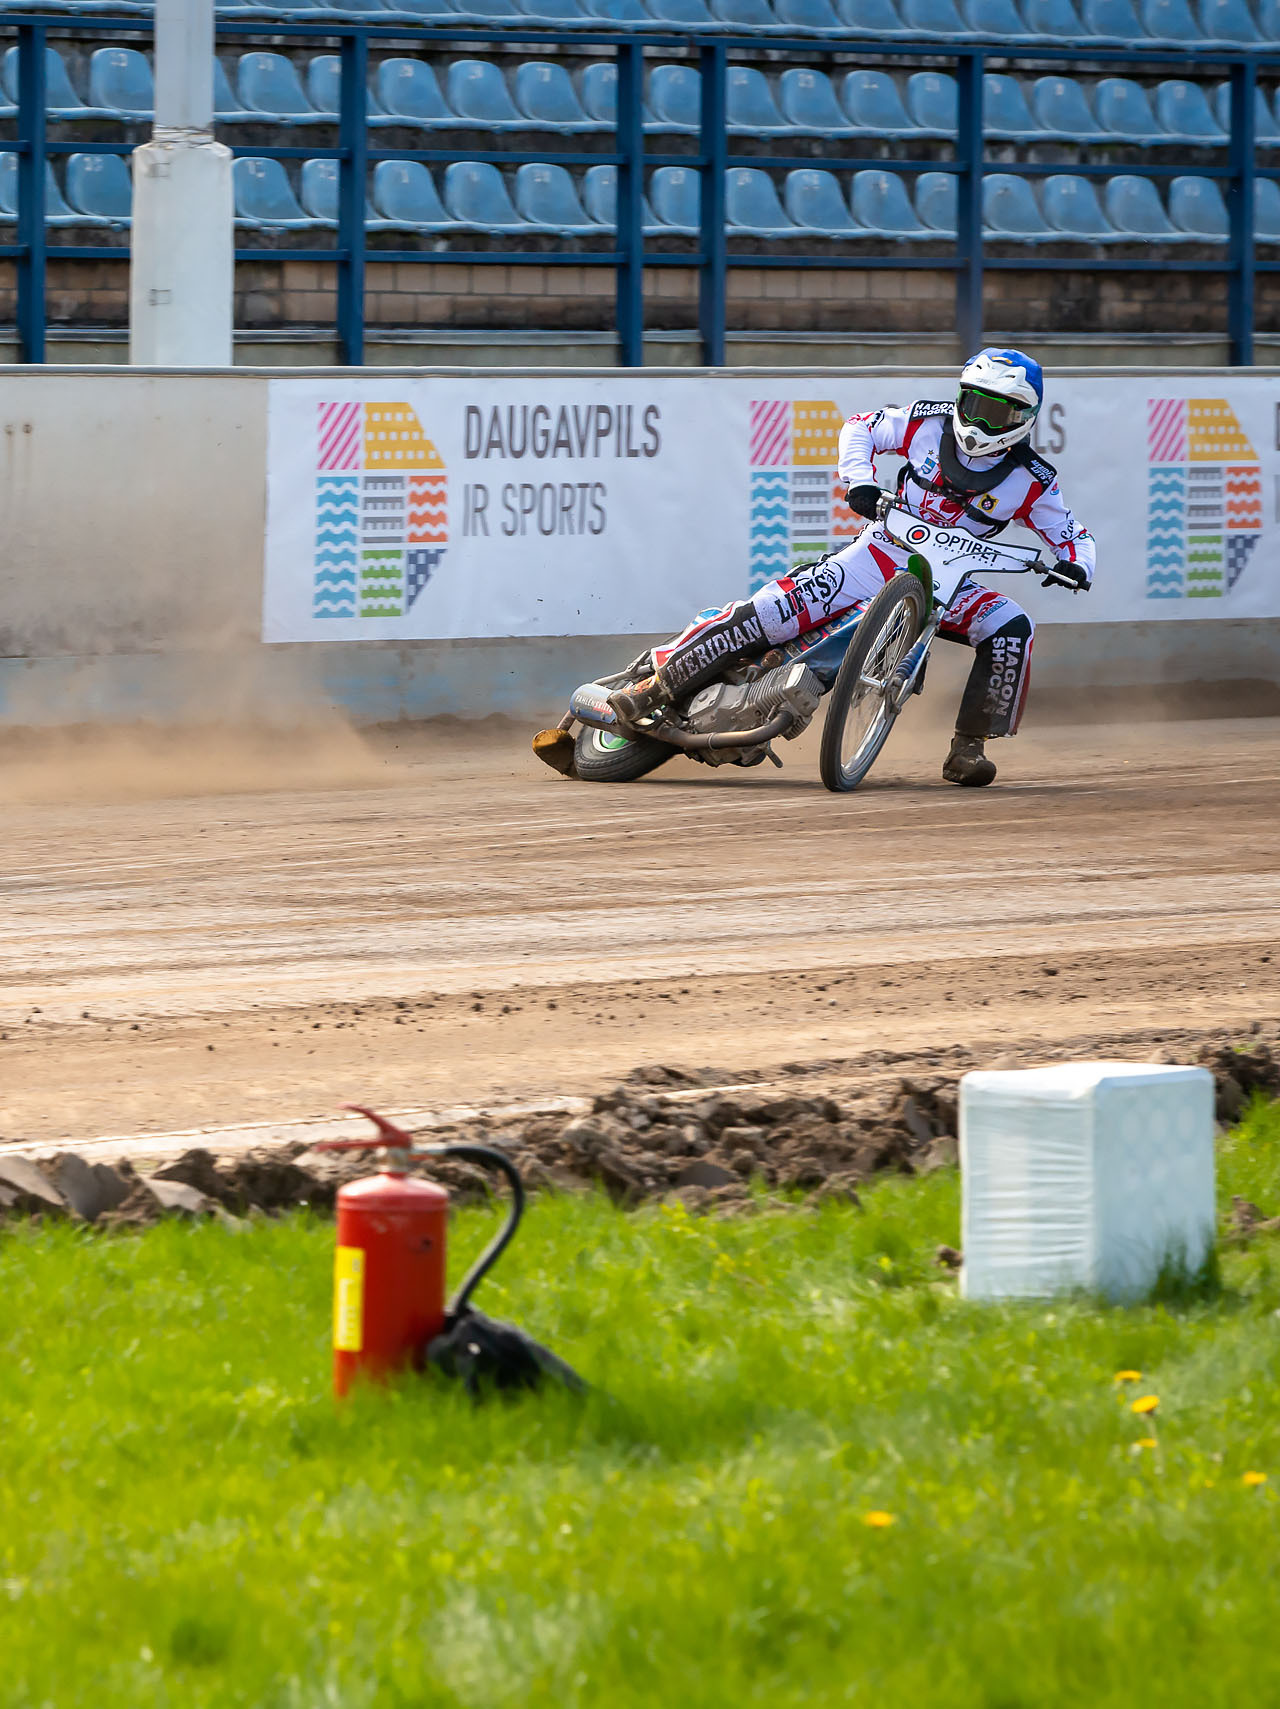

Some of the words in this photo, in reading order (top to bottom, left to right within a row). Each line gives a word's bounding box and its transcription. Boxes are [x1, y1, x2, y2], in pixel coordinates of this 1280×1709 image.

[464, 404, 662, 459] DAUGAVPILS
[462, 483, 490, 536] IR
[500, 482, 607, 536] SPORTS
[935, 532, 1002, 563] OPTIBET
[773, 573, 831, 624] LIFTS
[666, 616, 763, 688] MERIDIAN
[995, 636, 1021, 717] HAGON
